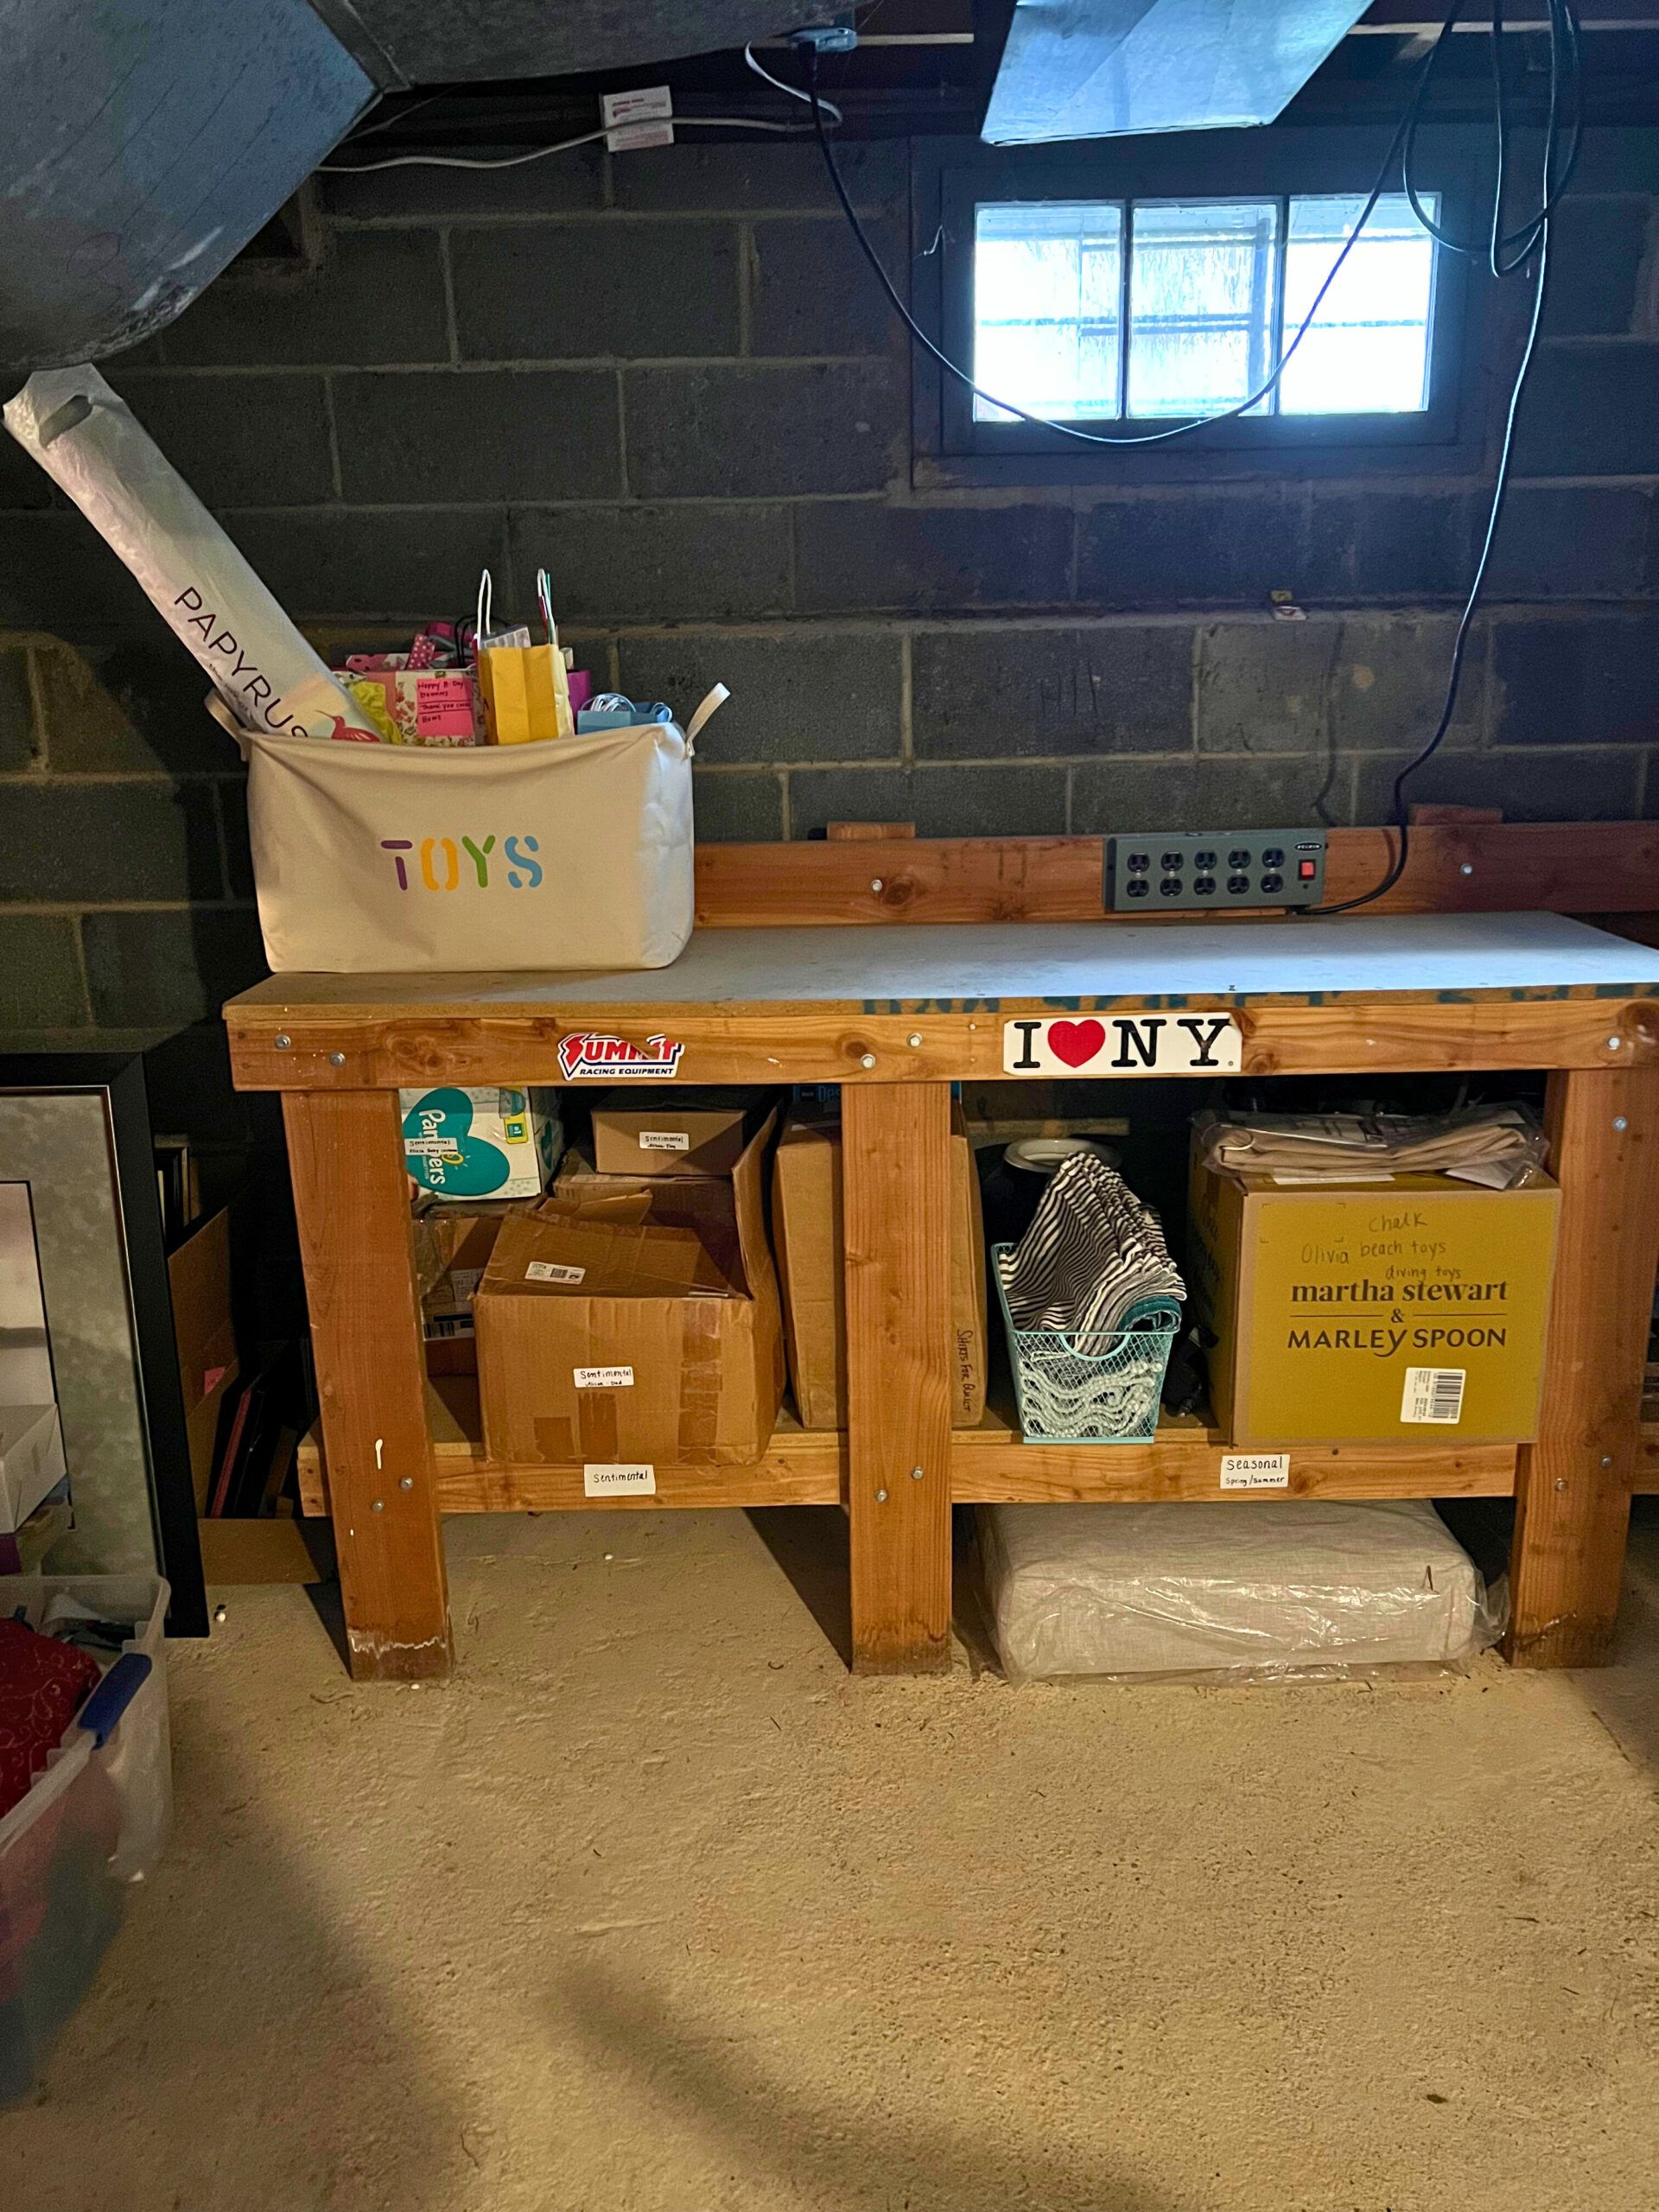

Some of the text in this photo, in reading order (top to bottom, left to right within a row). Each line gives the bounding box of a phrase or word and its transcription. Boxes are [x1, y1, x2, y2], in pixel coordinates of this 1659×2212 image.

[380, 835, 543, 891] TOYS
[1013, 1021, 1042, 1069] I
[1301, 1240, 1446, 1265] Olivia beach toys
[1385, 1264, 1462, 1281] diving toys
[1291, 1279, 1508, 1302] martha stewart
[1390, 1307, 1405, 1324] &
[1412, 1327, 1507, 1348] SPOON
[580, 1369, 632, 1380] Sentimental
